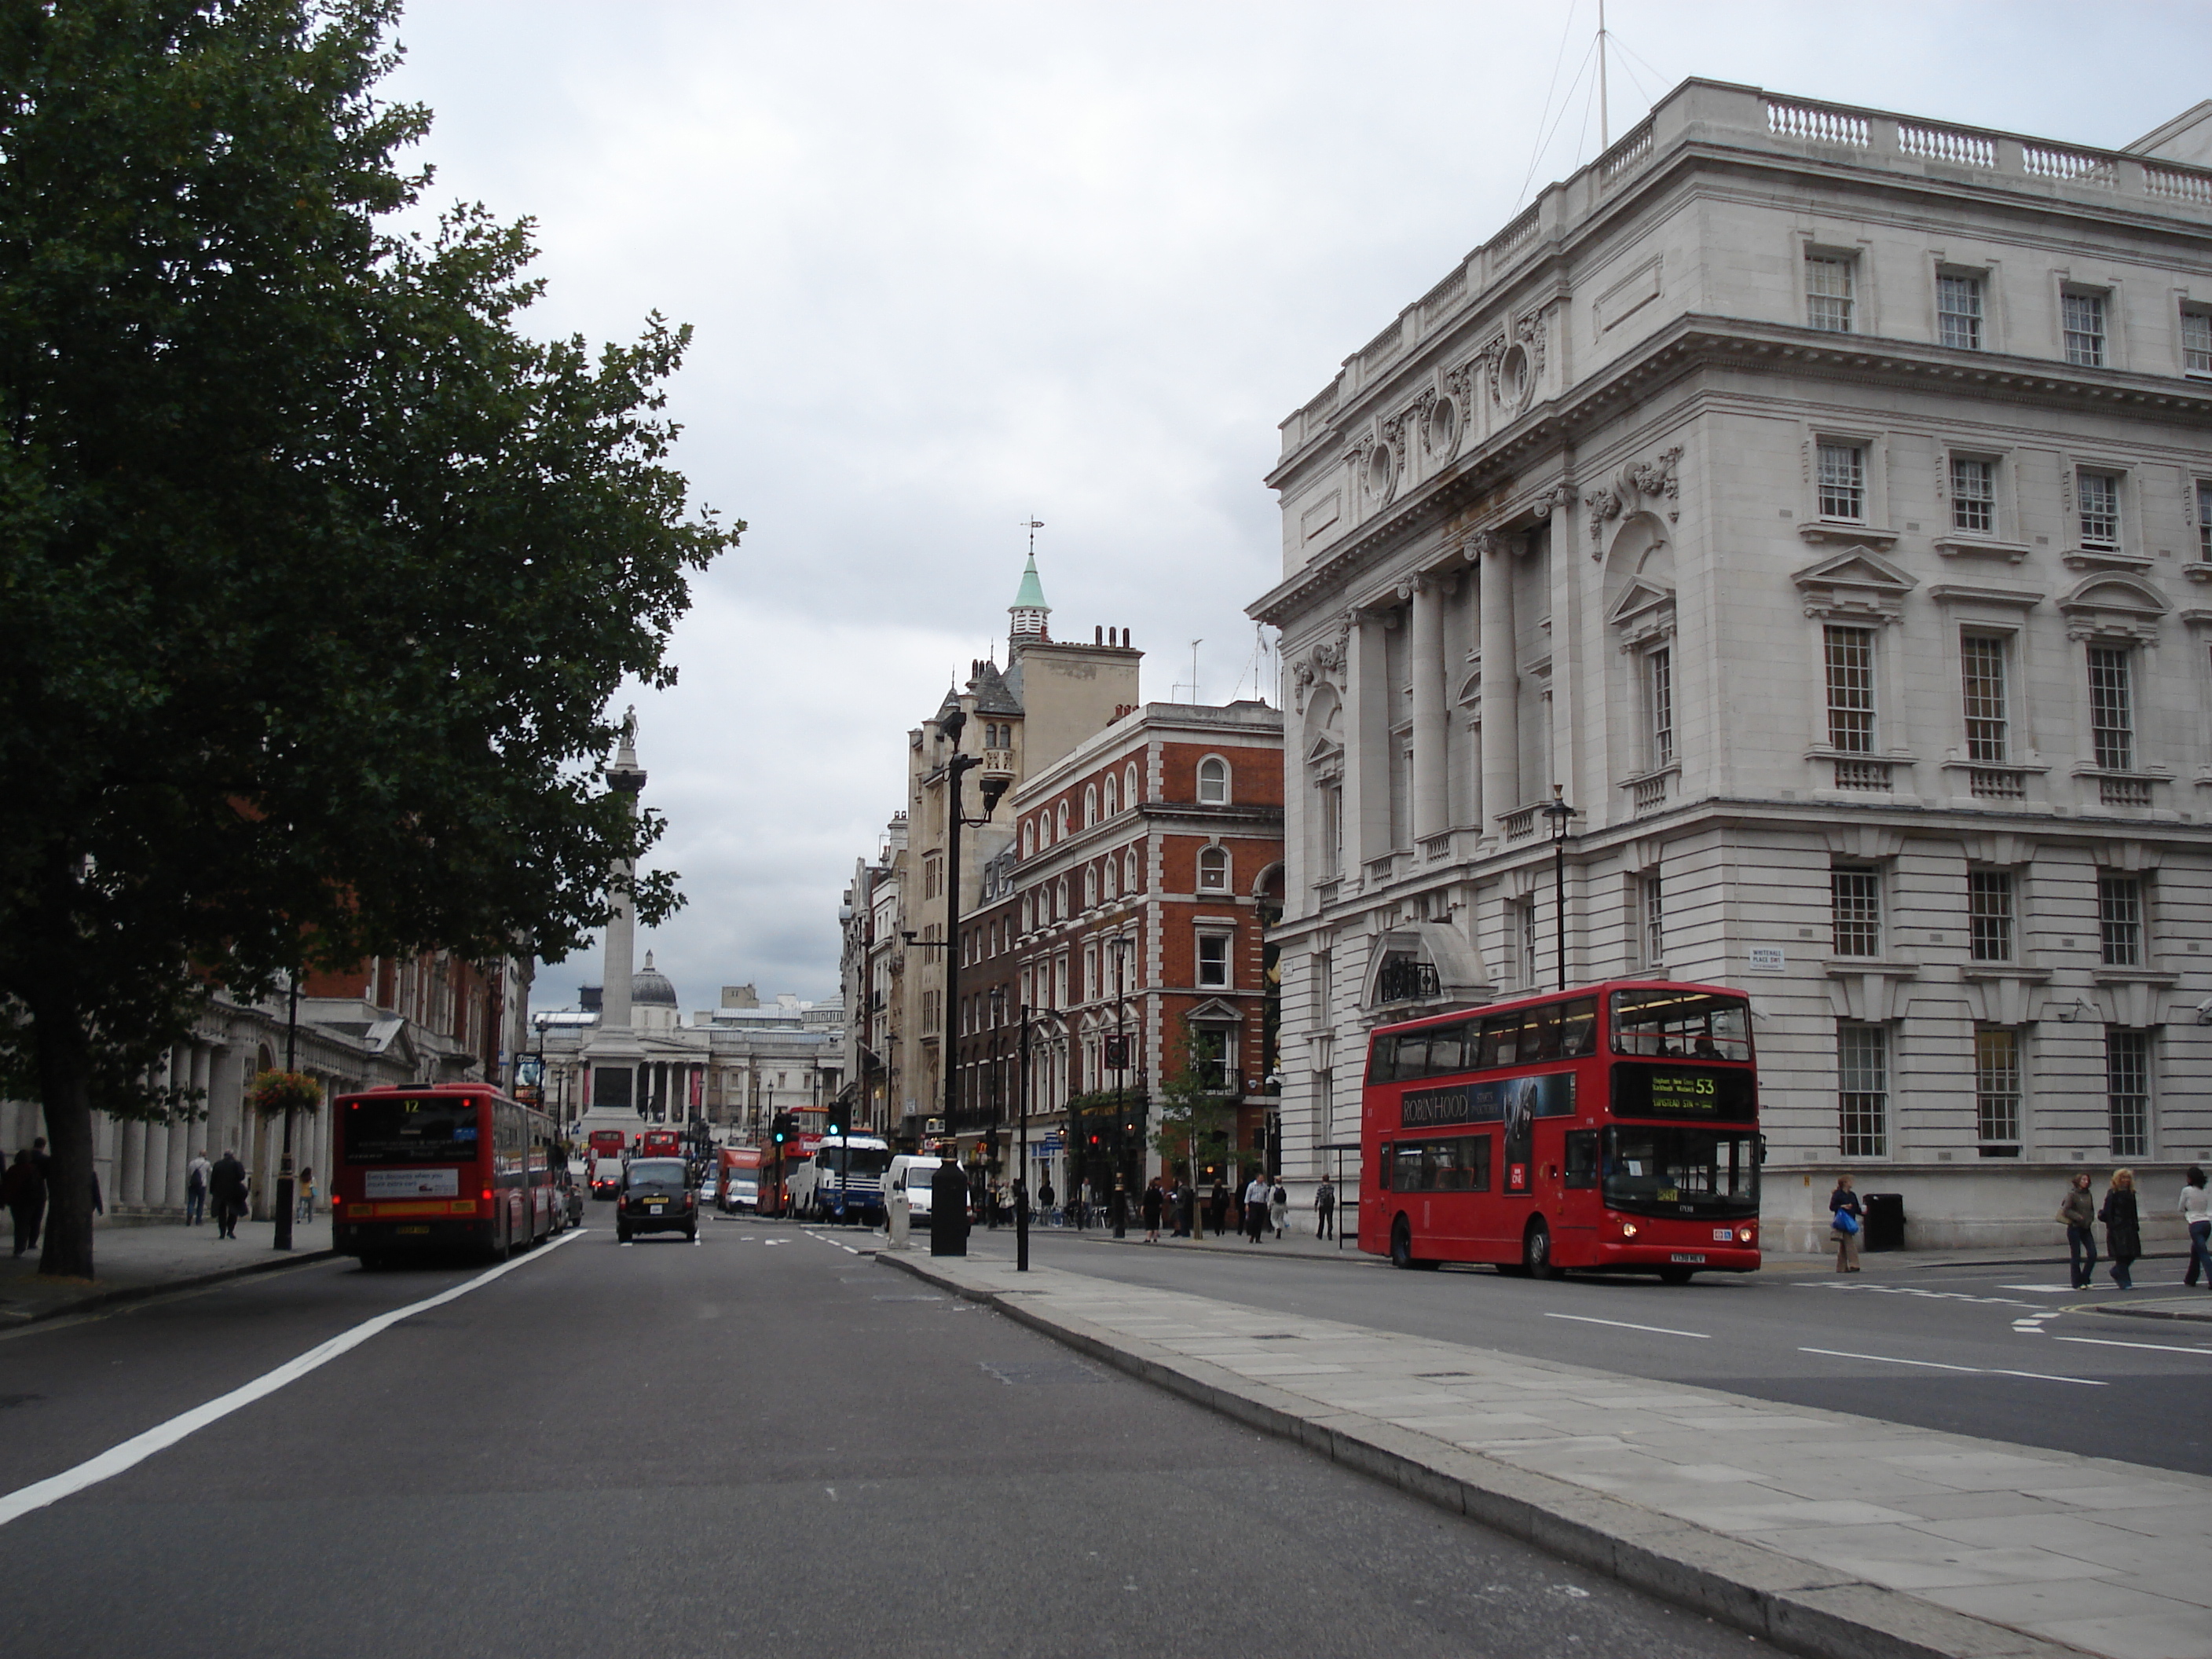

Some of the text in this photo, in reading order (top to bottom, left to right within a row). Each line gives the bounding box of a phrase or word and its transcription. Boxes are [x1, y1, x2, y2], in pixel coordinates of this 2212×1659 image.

[1696, 1079, 1714, 1094] 53
[404, 1100, 419, 1113] 12
[1404, 1094, 1468, 1122] ROBIN HOOD
